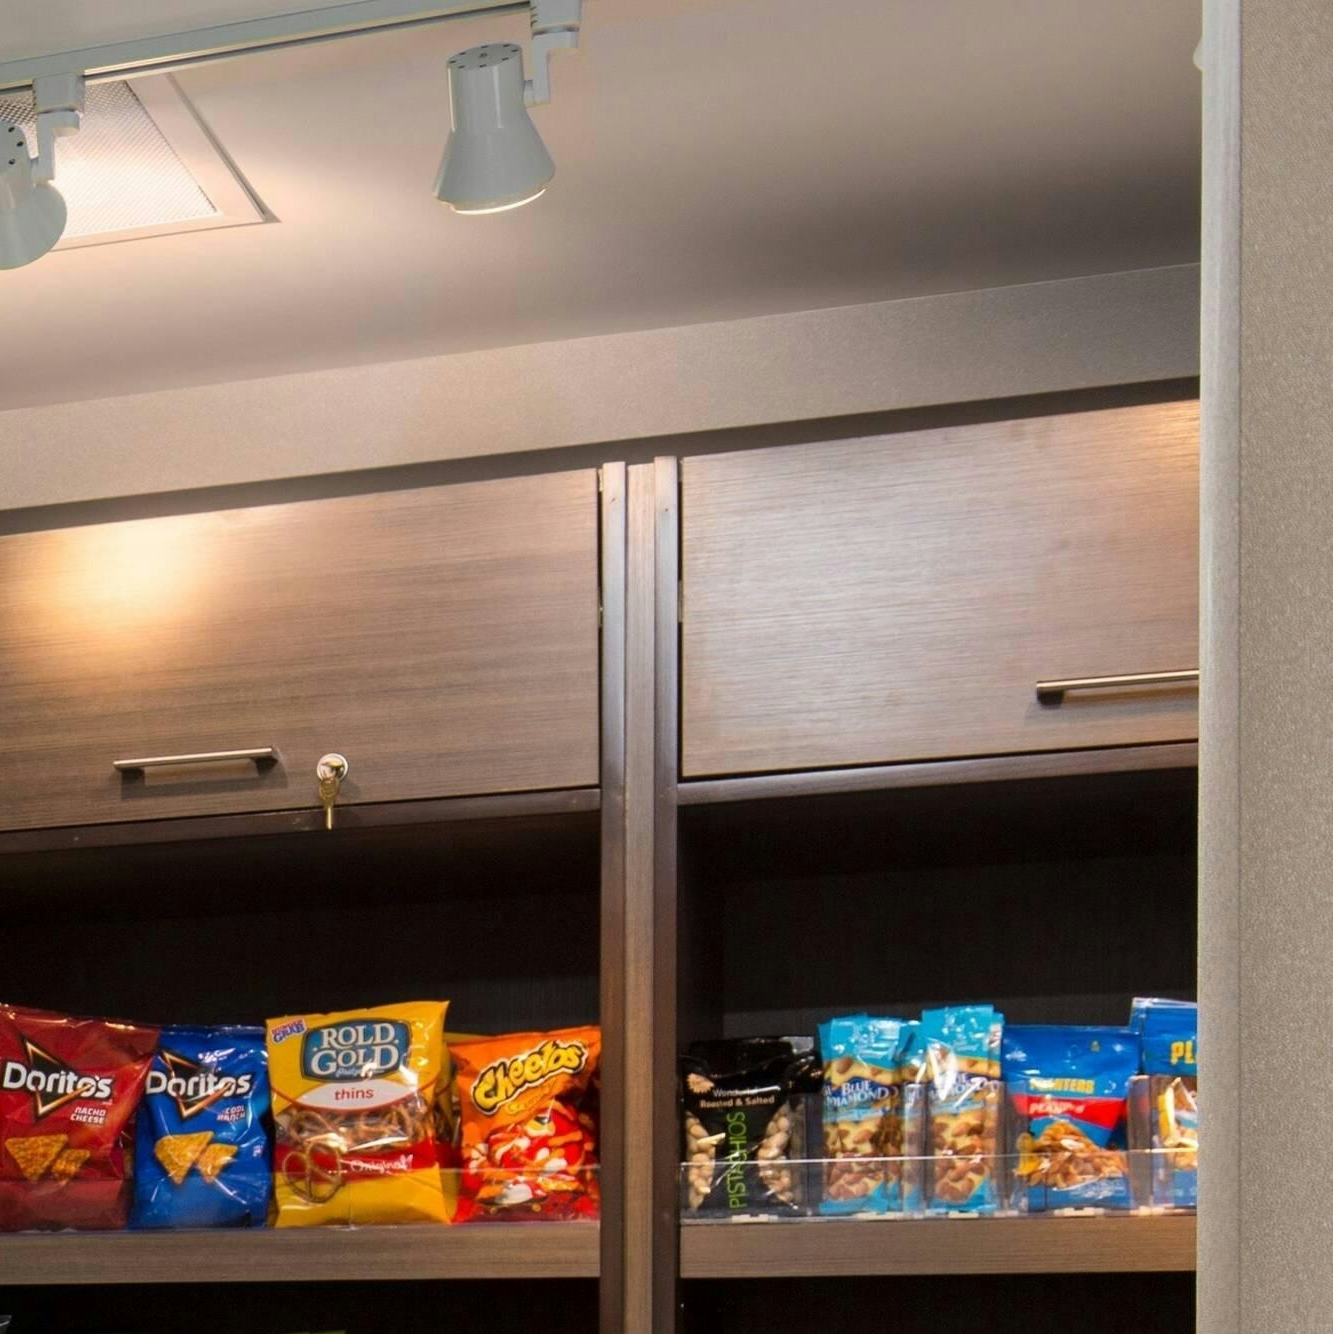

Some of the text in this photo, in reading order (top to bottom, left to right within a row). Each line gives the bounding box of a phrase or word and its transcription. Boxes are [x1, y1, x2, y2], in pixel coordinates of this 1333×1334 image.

[321, 1023, 395, 1050] ROLD
[311, 1045, 399, 1075] GOLD
[3, 1061, 114, 1099] Doritos
[146, 1071, 252, 1097] Doritos
[474, 1040, 585, 1112] Cheetos
[335, 1088, 374, 1101] thins
[842, 1080, 872, 1094] BLUE
[74, 1106, 107, 1117] NACHO
[700, 1095, 775, 1108] Roasted & Salted
[70, 1114, 107, 1124] CHEESE
